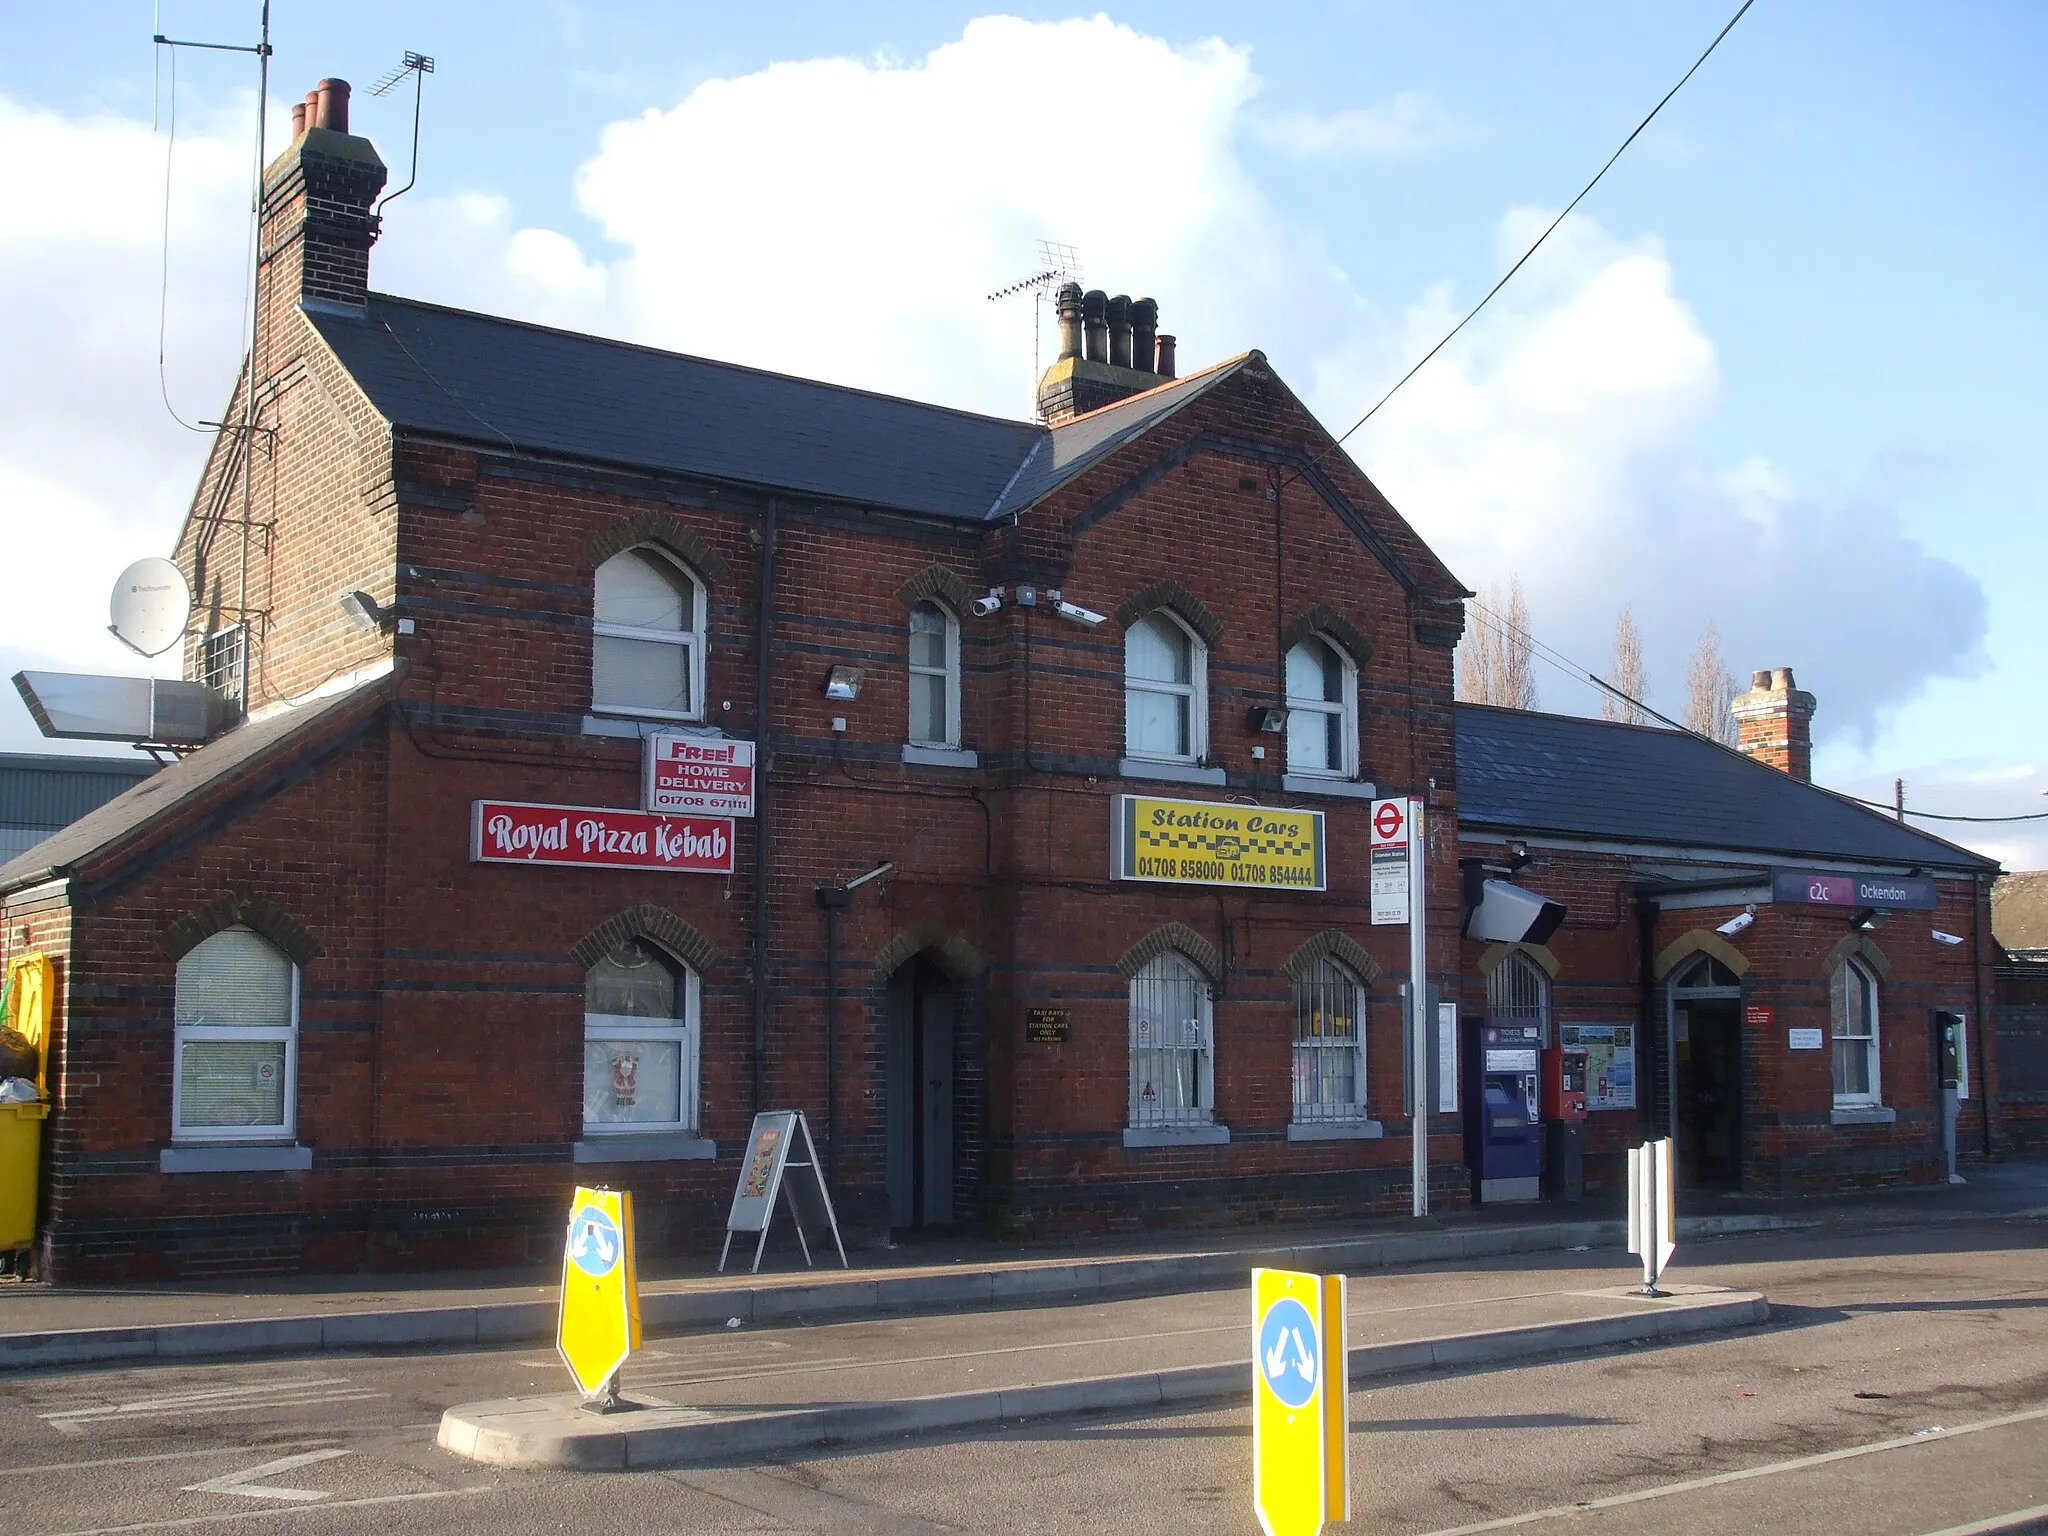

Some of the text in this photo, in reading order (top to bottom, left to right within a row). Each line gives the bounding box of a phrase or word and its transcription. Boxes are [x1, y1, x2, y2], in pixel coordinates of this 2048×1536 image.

[677, 764, 730, 778] HOME
[659, 776, 747, 792] DELIVERY
[658, 794, 747, 810] 01708 671111
[1151, 808, 1299, 838] Station Cars
[488, 814, 727, 862] Royal Pizza Kebab
[1139, 857, 1312, 885] 01708 858000 01708 854444
[1809, 883, 1829, 901] c2c
[1860, 884, 1906, 900] Ockendon
